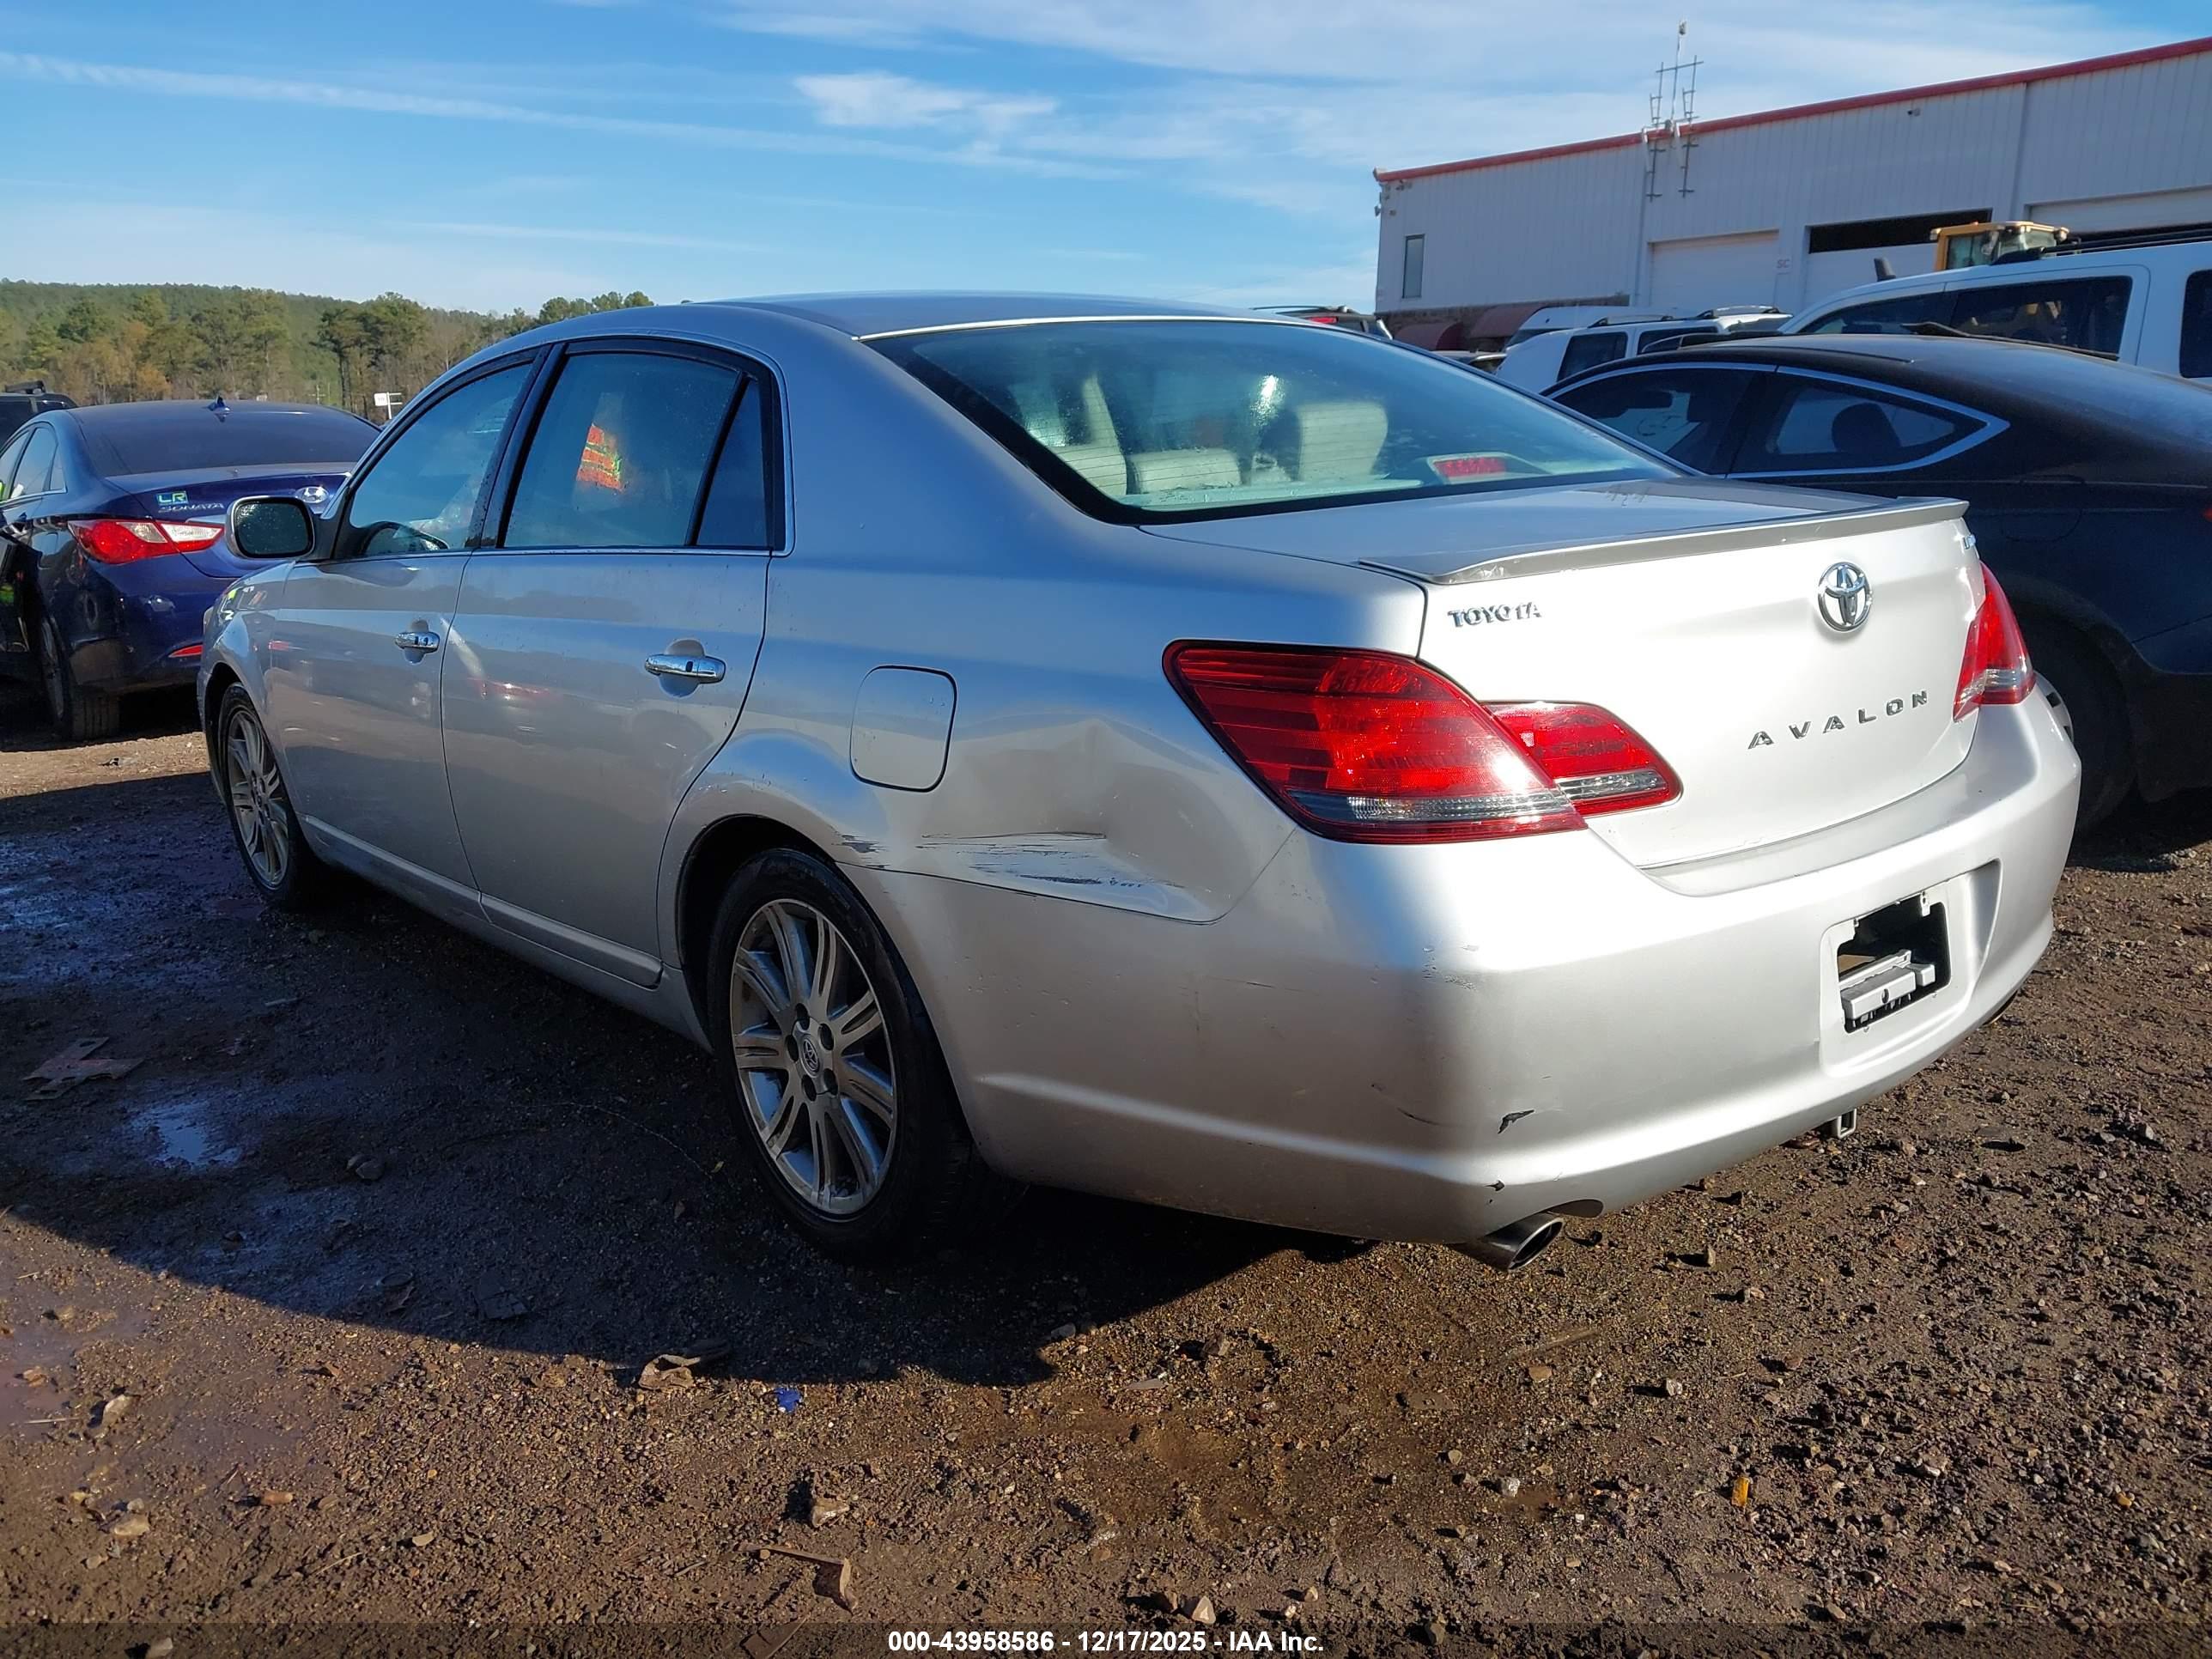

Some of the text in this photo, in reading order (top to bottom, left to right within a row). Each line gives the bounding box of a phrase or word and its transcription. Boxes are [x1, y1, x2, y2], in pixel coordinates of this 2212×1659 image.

[158, 502, 225, 514] SONATA
[1447, 602, 1542, 628] TOYOTA
[1747, 690, 1928, 750] AVALON
